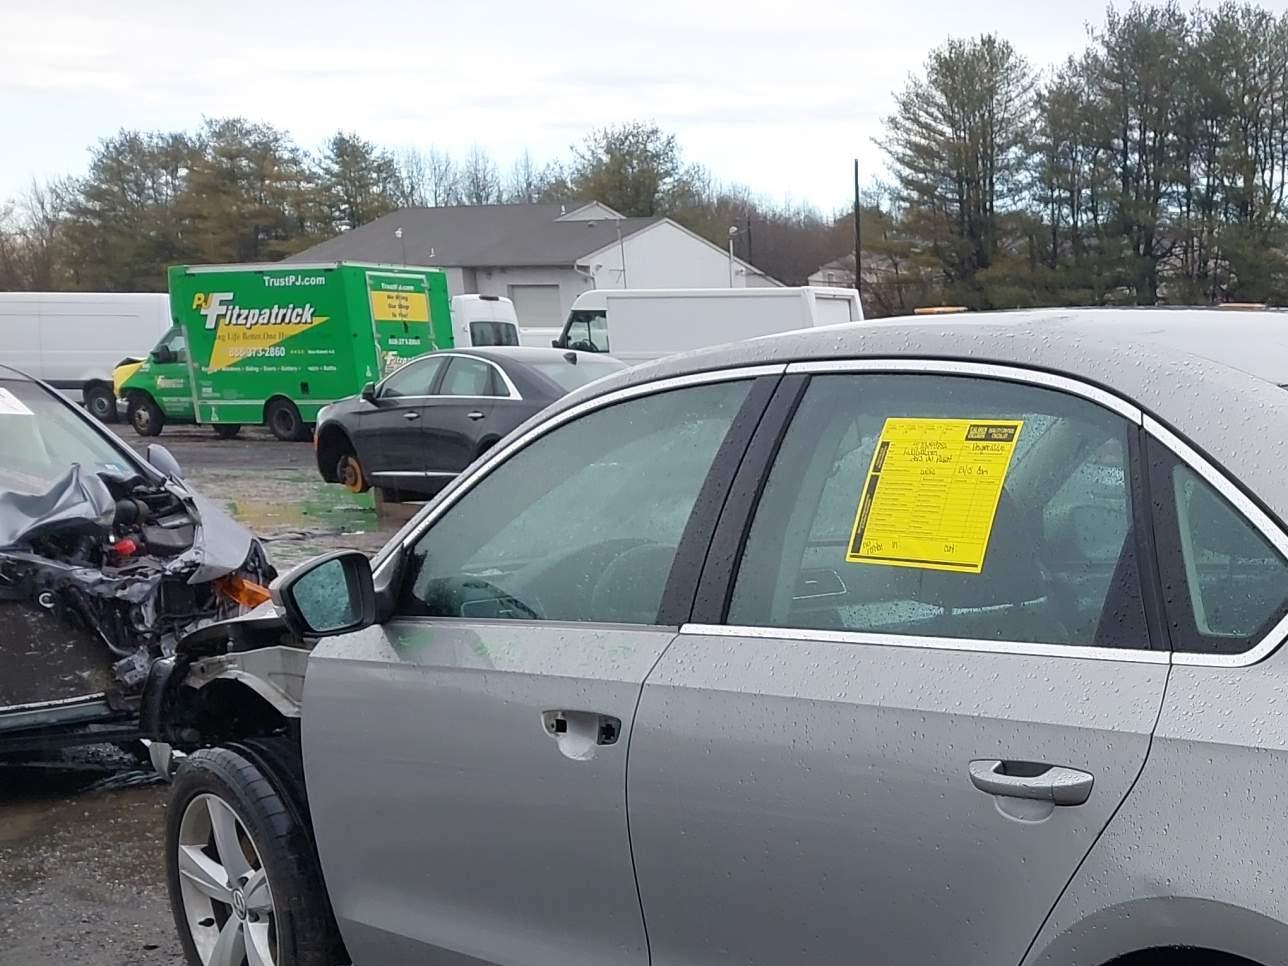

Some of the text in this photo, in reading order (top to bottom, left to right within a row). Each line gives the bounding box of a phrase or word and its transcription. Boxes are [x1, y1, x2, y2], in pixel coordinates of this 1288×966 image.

[263, 275, 326, 287] TrustPJ.com
[192, 292, 315, 329] PJ Fitzpatrick
